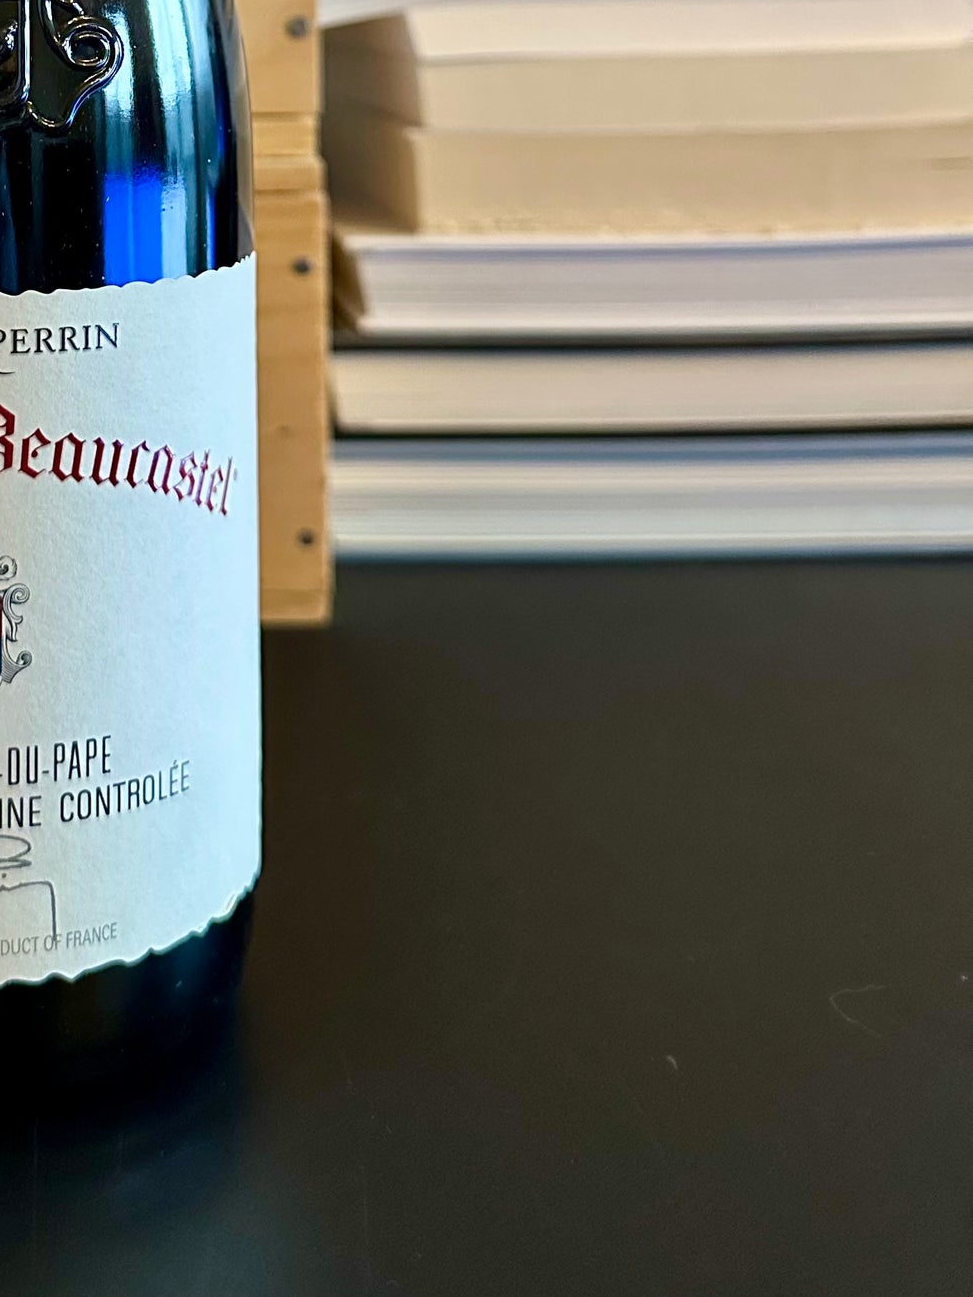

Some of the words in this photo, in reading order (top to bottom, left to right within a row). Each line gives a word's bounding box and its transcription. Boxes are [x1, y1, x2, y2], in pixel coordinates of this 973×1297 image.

[59, 759, 191, 824] CONTROLÉE
[43, 933, 63, 952] OF
[65, 921, 118, 949] FRANCE
